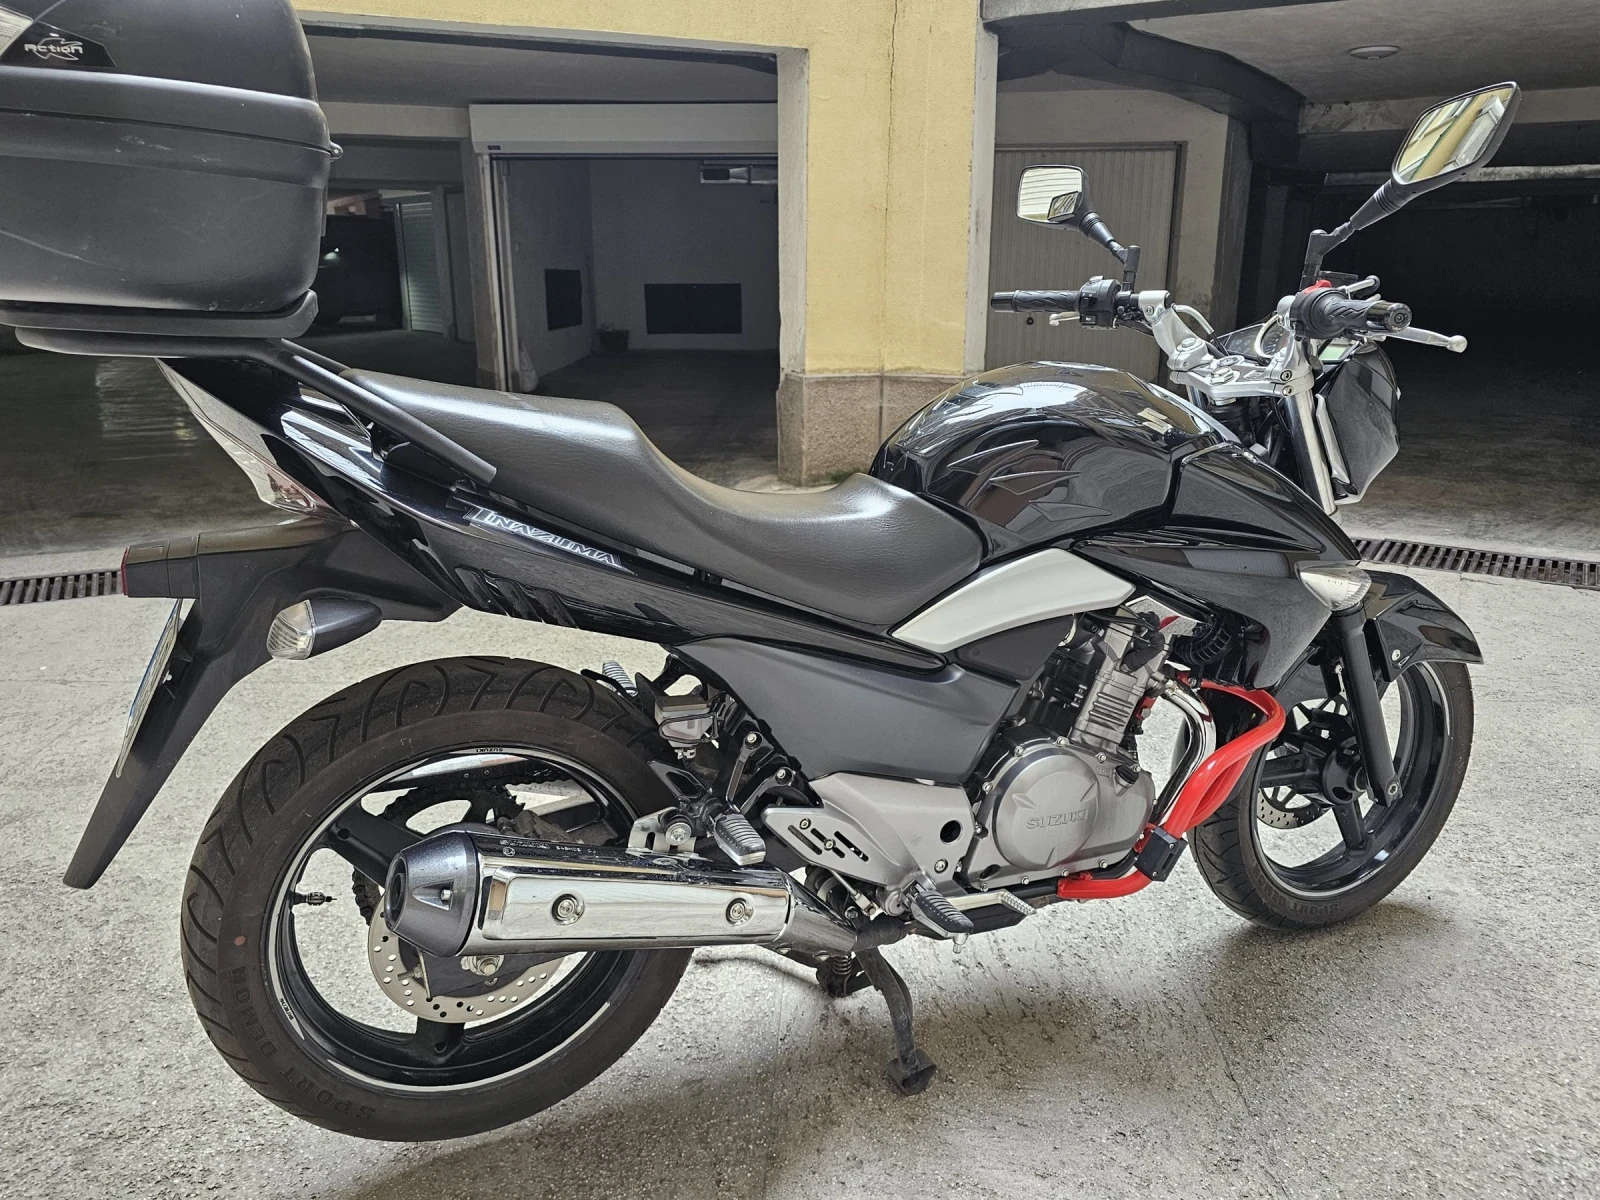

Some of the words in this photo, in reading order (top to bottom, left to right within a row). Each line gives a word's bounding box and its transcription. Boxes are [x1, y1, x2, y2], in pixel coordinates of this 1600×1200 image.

[463, 506, 621, 566] INAZUMA
[1026, 809, 1089, 830] SUZUKI
[231, 965, 278, 1062] DEMON
[279, 1066, 376, 1120] SPORT
